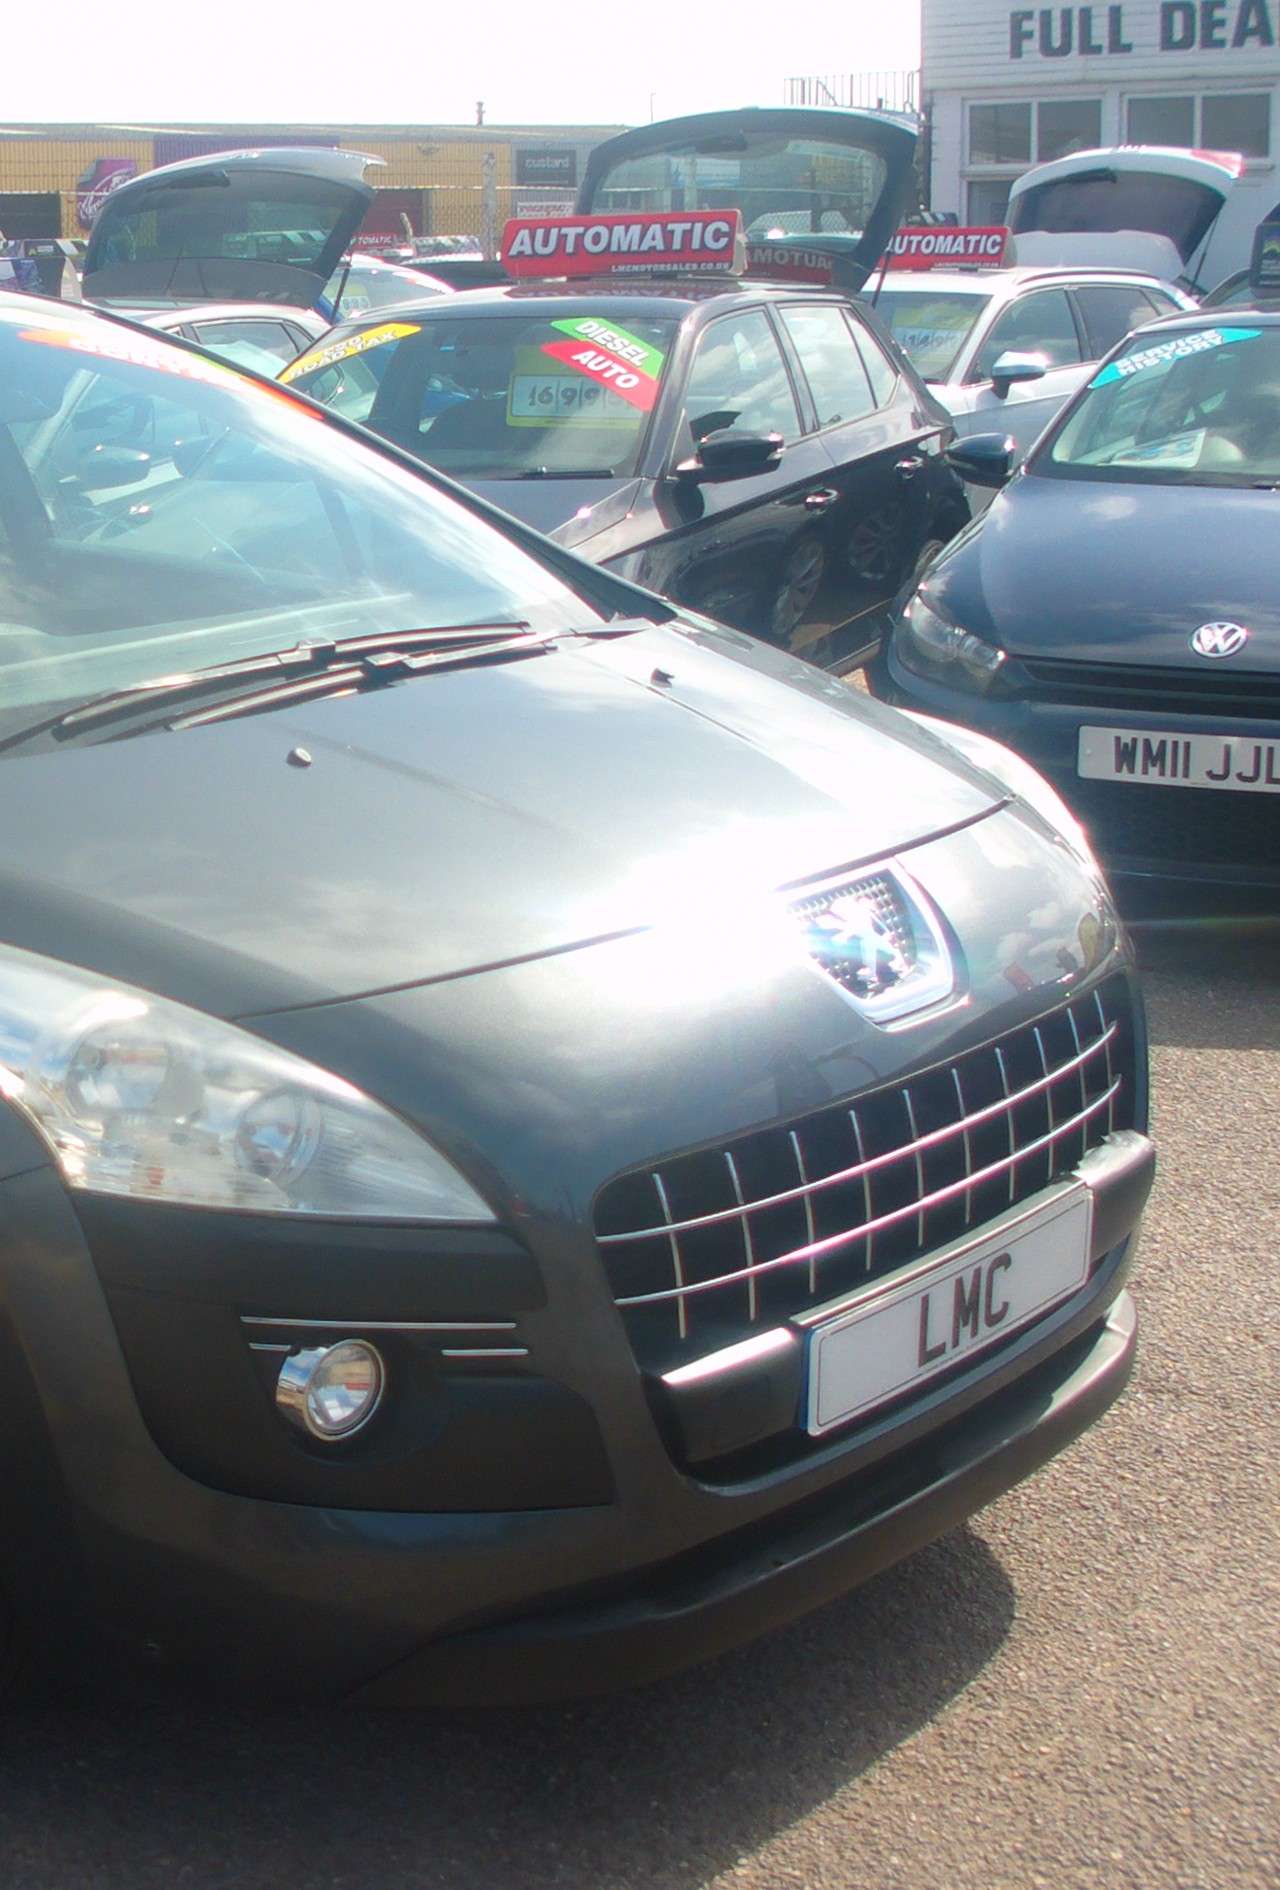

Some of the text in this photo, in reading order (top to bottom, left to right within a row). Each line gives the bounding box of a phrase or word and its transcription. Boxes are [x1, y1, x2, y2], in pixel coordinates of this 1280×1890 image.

[1009, 0, 1280, 59] FULL DEA
[508, 220, 730, 257] AUTOMATIC
[575, 320, 649, 367] DIESEL
[1115, 329, 1220, 369] SERVICE
[1119, 335, 1224, 376] HISTORY
[571, 350, 640, 388] AUTO
[1114, 735, 1280, 785] WM11 JJL
[918, 1251, 1012, 1368] LMC
